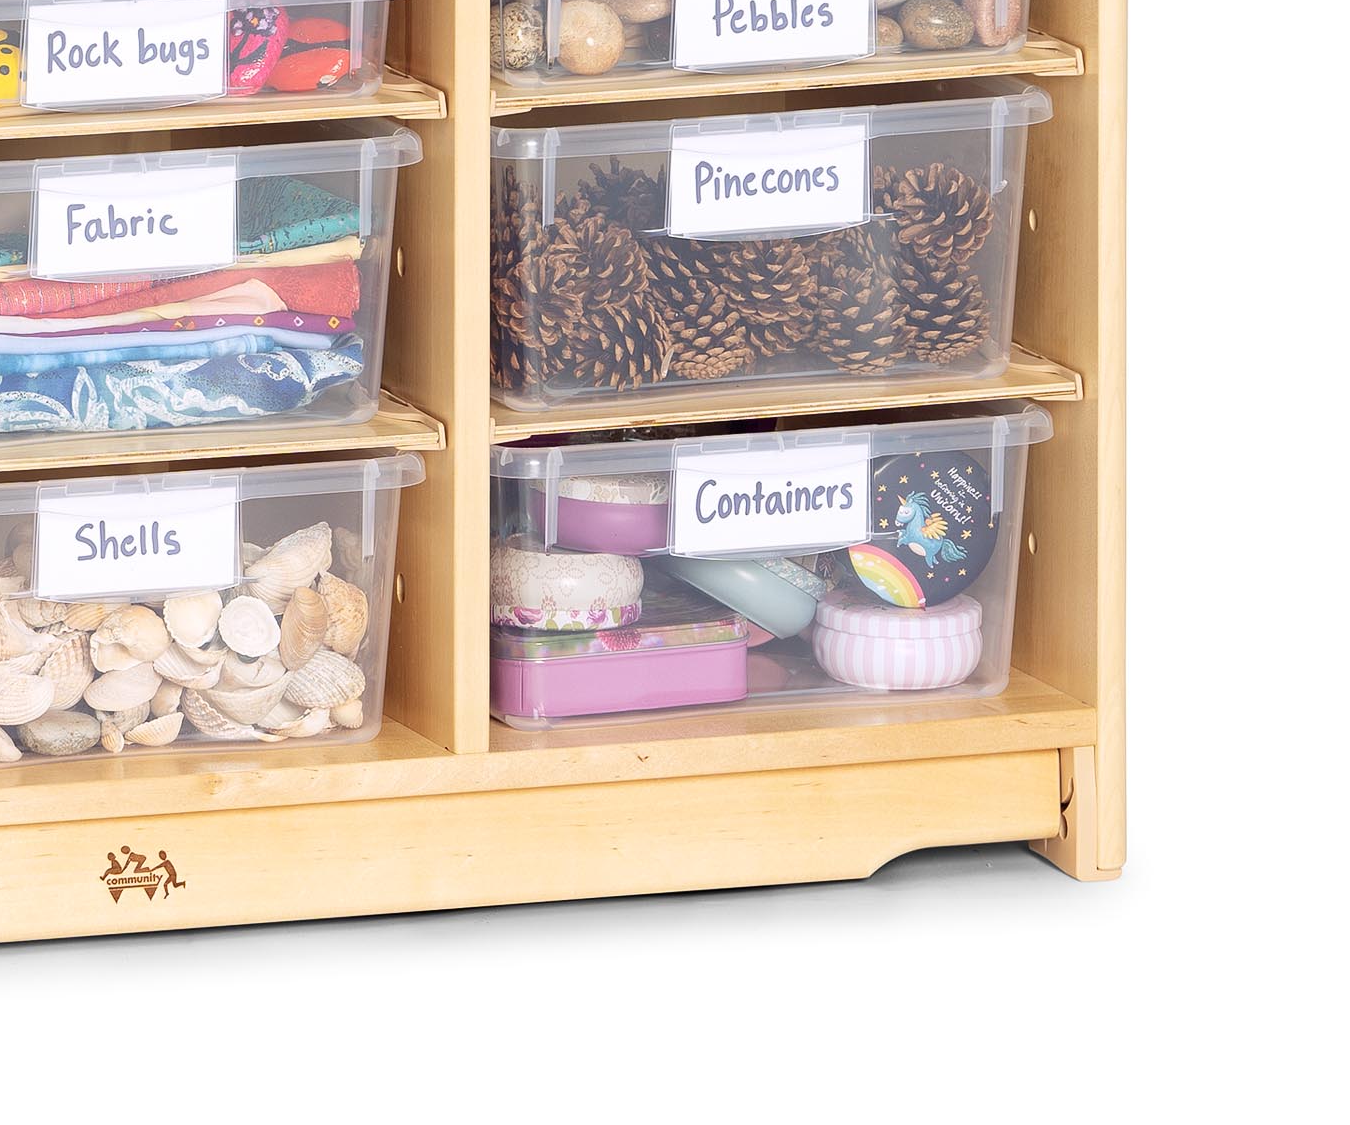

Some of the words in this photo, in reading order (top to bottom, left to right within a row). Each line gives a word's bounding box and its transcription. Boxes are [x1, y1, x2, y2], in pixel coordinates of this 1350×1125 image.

[47, 30, 122, 73] Rock
[138, 28, 211, 76] bugs
[695, 160, 839, 205] Pinecones
[67, 204, 179, 244] Fabric
[696, 478, 854, 524] Containers
[75, 520, 181, 562] Shells
[106, 873, 163, 886] community
